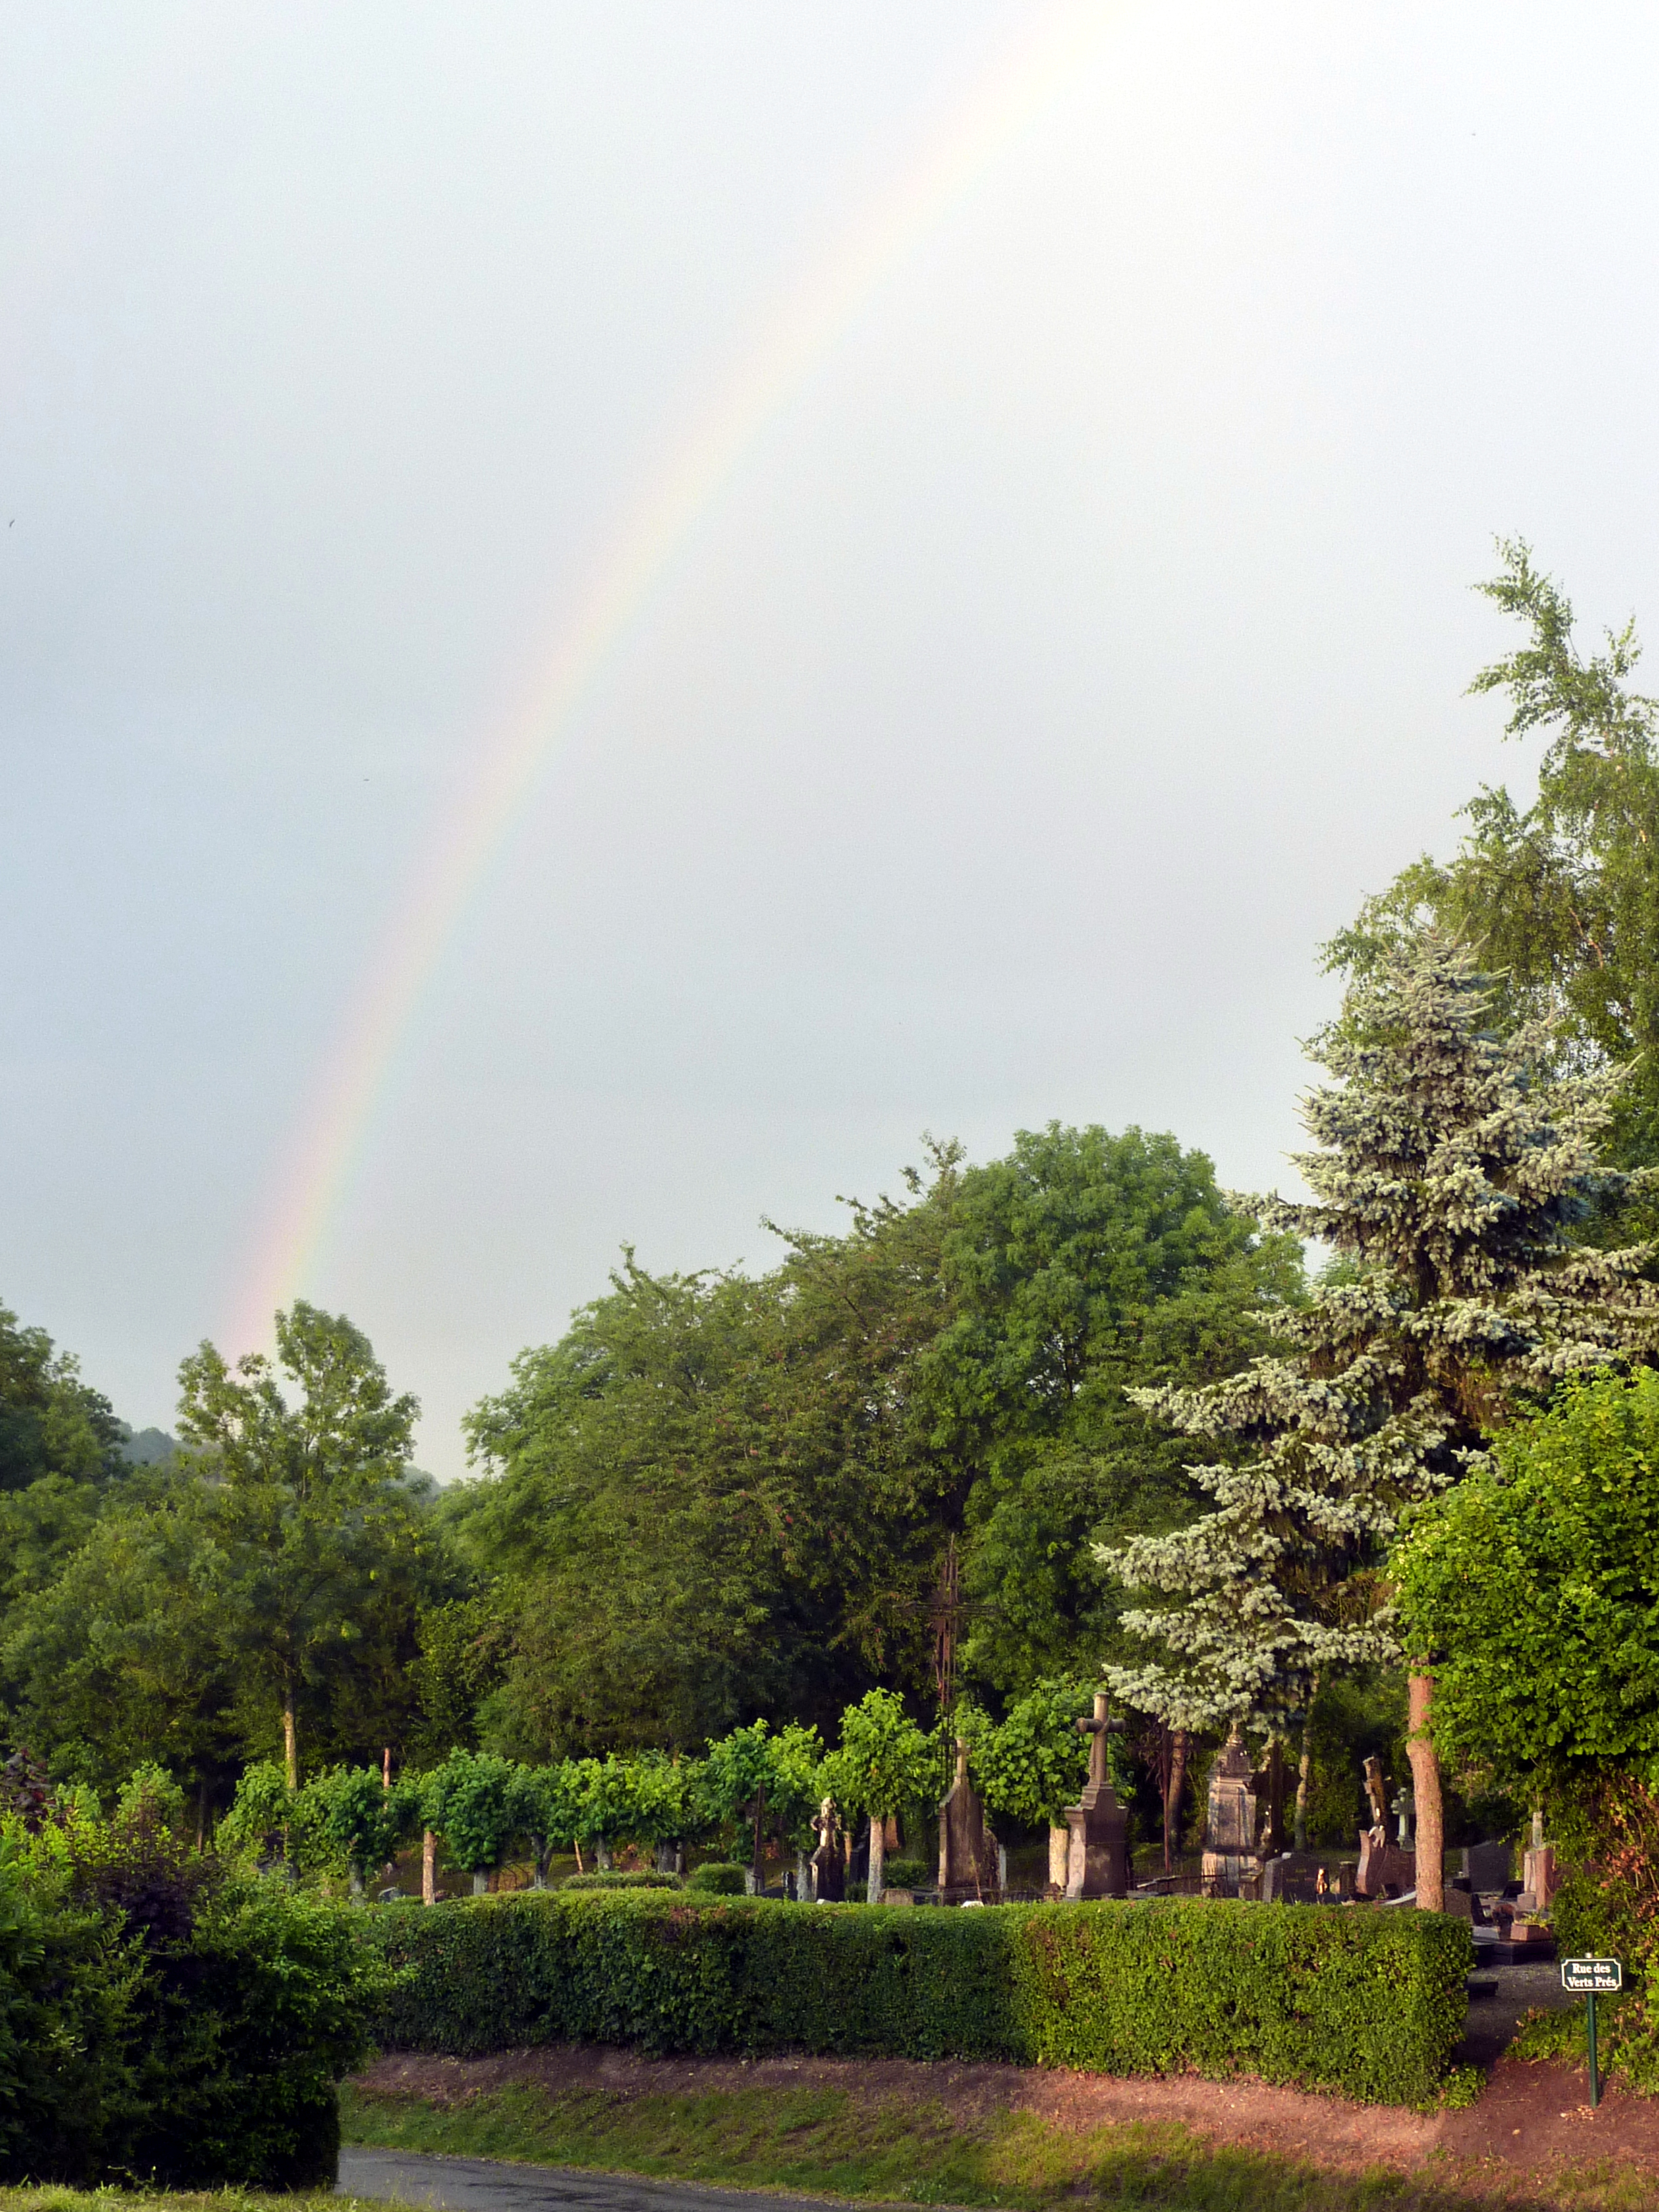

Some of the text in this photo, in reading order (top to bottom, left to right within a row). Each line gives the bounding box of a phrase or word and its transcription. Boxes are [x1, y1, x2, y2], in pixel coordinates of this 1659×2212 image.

[1572, 1963, 1611, 1974] Rue des
[1567, 1976, 1616, 1987] Verts Prés
